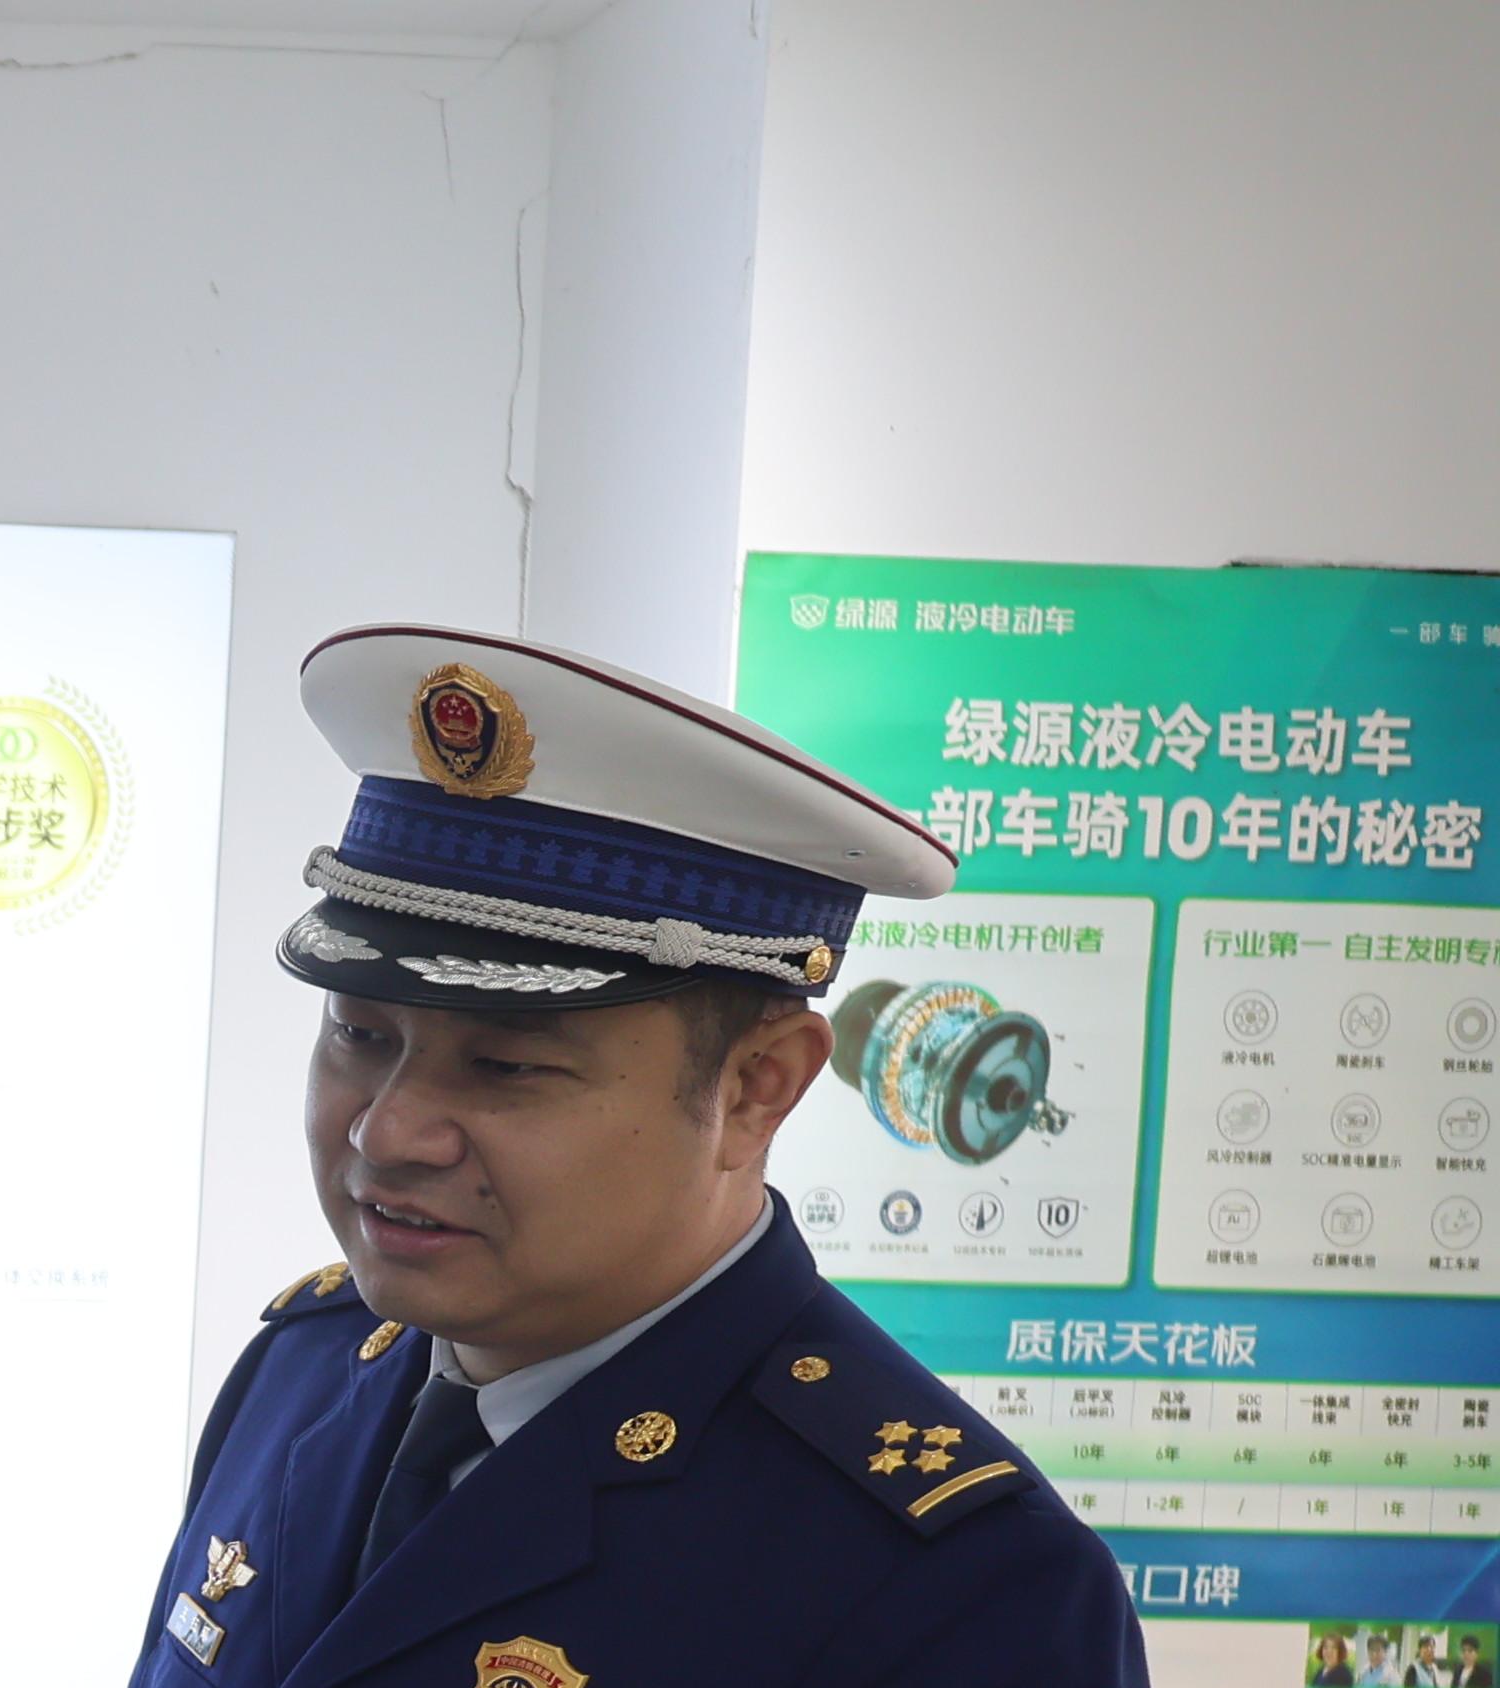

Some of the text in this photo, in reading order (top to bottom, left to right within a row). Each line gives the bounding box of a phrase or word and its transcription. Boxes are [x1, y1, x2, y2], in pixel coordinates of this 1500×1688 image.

[835, 597, 1075, 636] 绿源 液冷电动车
[942, 697, 1413, 777] 绿源液冷电动车
[1203, 929, 1332, 958] 行业第一
[1005, 1319, 1259, 1367] 质保天花板
[1073, 1445, 1492, 1471] 10年 6年 6年 6年 6年 3-5年
[1074, 1493, 1097, 1511] 1年
[1307, 1499, 1329, 1515] 1年
[1383, 1501, 1405, 1517] 1年
[1458, 1502, 1481, 1518] 1年
